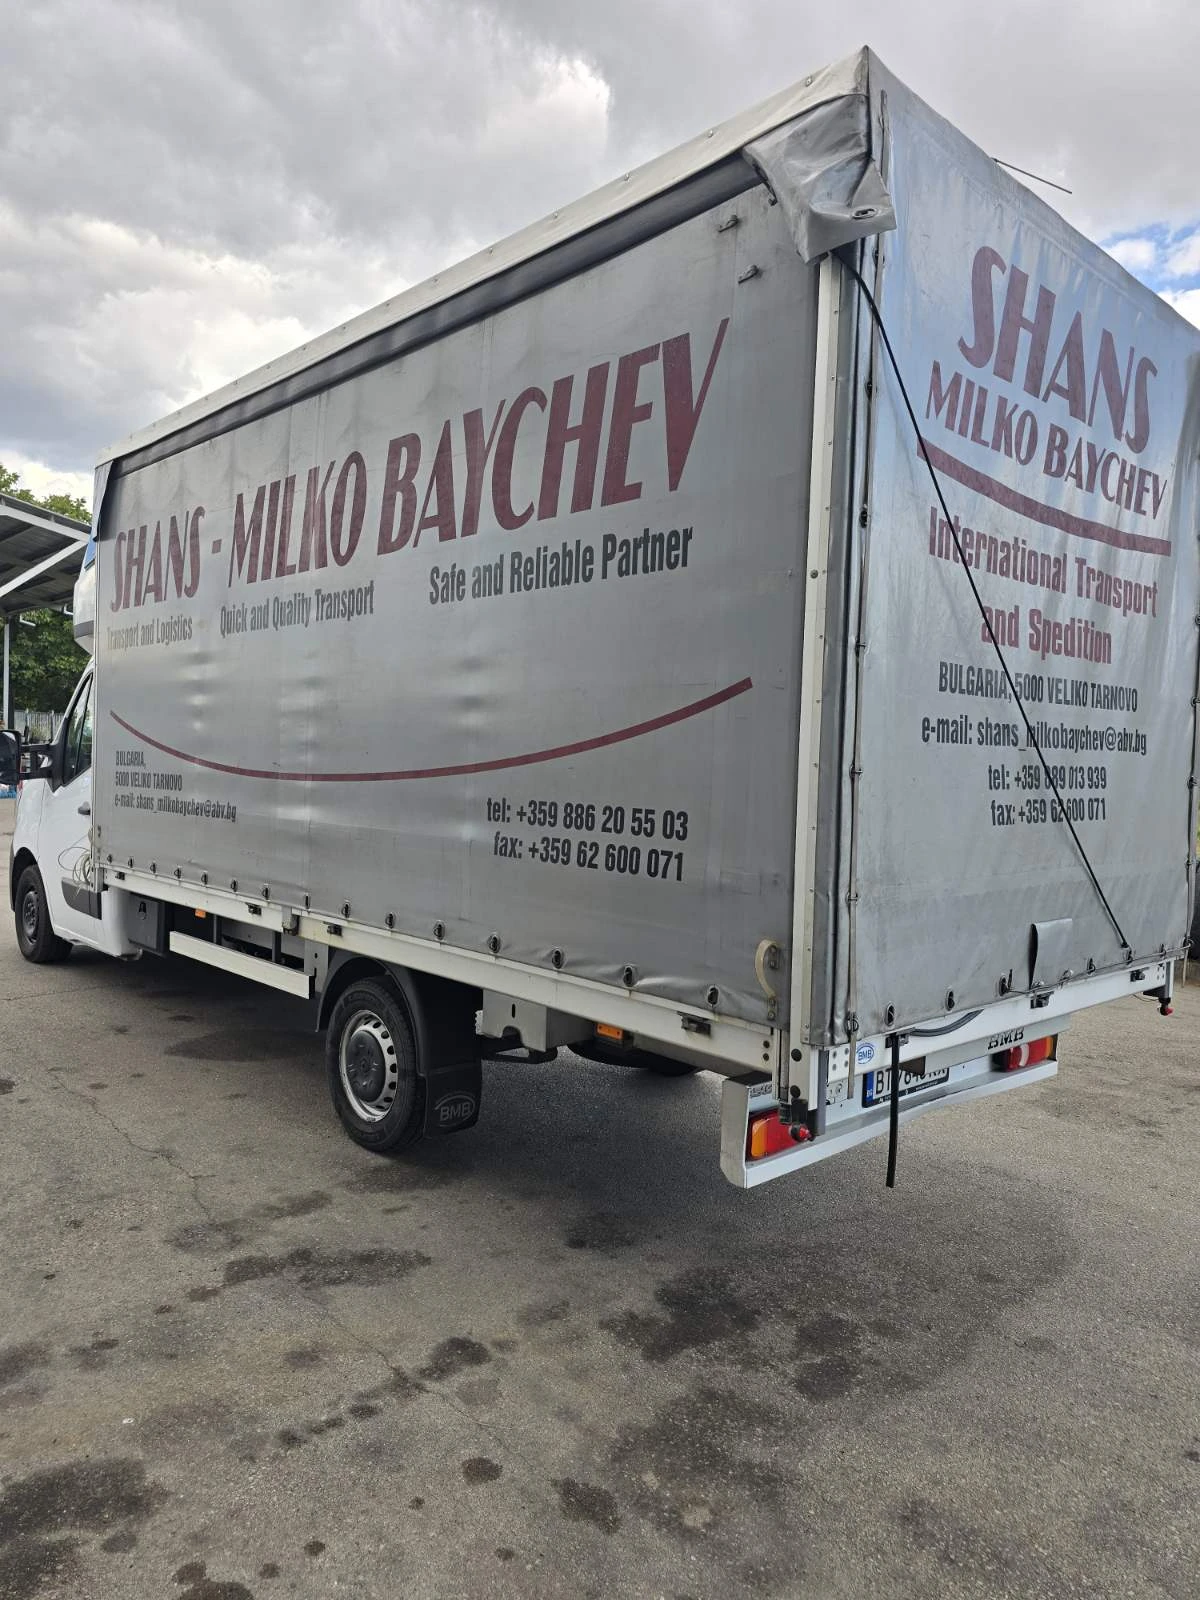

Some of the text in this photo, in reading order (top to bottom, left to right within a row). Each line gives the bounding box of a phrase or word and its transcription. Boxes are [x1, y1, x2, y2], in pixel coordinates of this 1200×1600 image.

[958, 246, 1158, 454] SHANS
[925, 360, 1167, 520] MILKO BAYCHEV
[111, 506, 205, 612] SHANS
[228, 451, 367, 588] MILKO
[377, 317, 730, 556] BAYCHEV
[429, 526, 693, 605] Safe and Reliable Partner
[929, 506, 1158, 618] International Transport
[220, 580, 374, 638] Quick and Quality Transport
[106, 614, 192, 651] Transport and Logistics
[981, 605, 1112, 664] and Spedition
[939, 661, 1138, 712] BULGARIA, 5000 VELIKO TARNOVO
[921, 714, 973, 745] e-mail:
[115, 771, 183, 792] 5000 VELIKO TARNOVO
[116, 750, 147, 769] BULGARIA,
[988, 764, 1107, 790] tel: +359 889 013 939
[114, 792, 135, 809] e-mail:
[487, 797, 689, 841] tel: +359 886 20 55 03
[990, 798, 1106, 826] fax: +359 62 600 071
[494, 831, 684, 882] fax: +359 62 600 071
[858, 1049, 872, 1061] BMB
[440, 1102, 472, 1121] BMB
